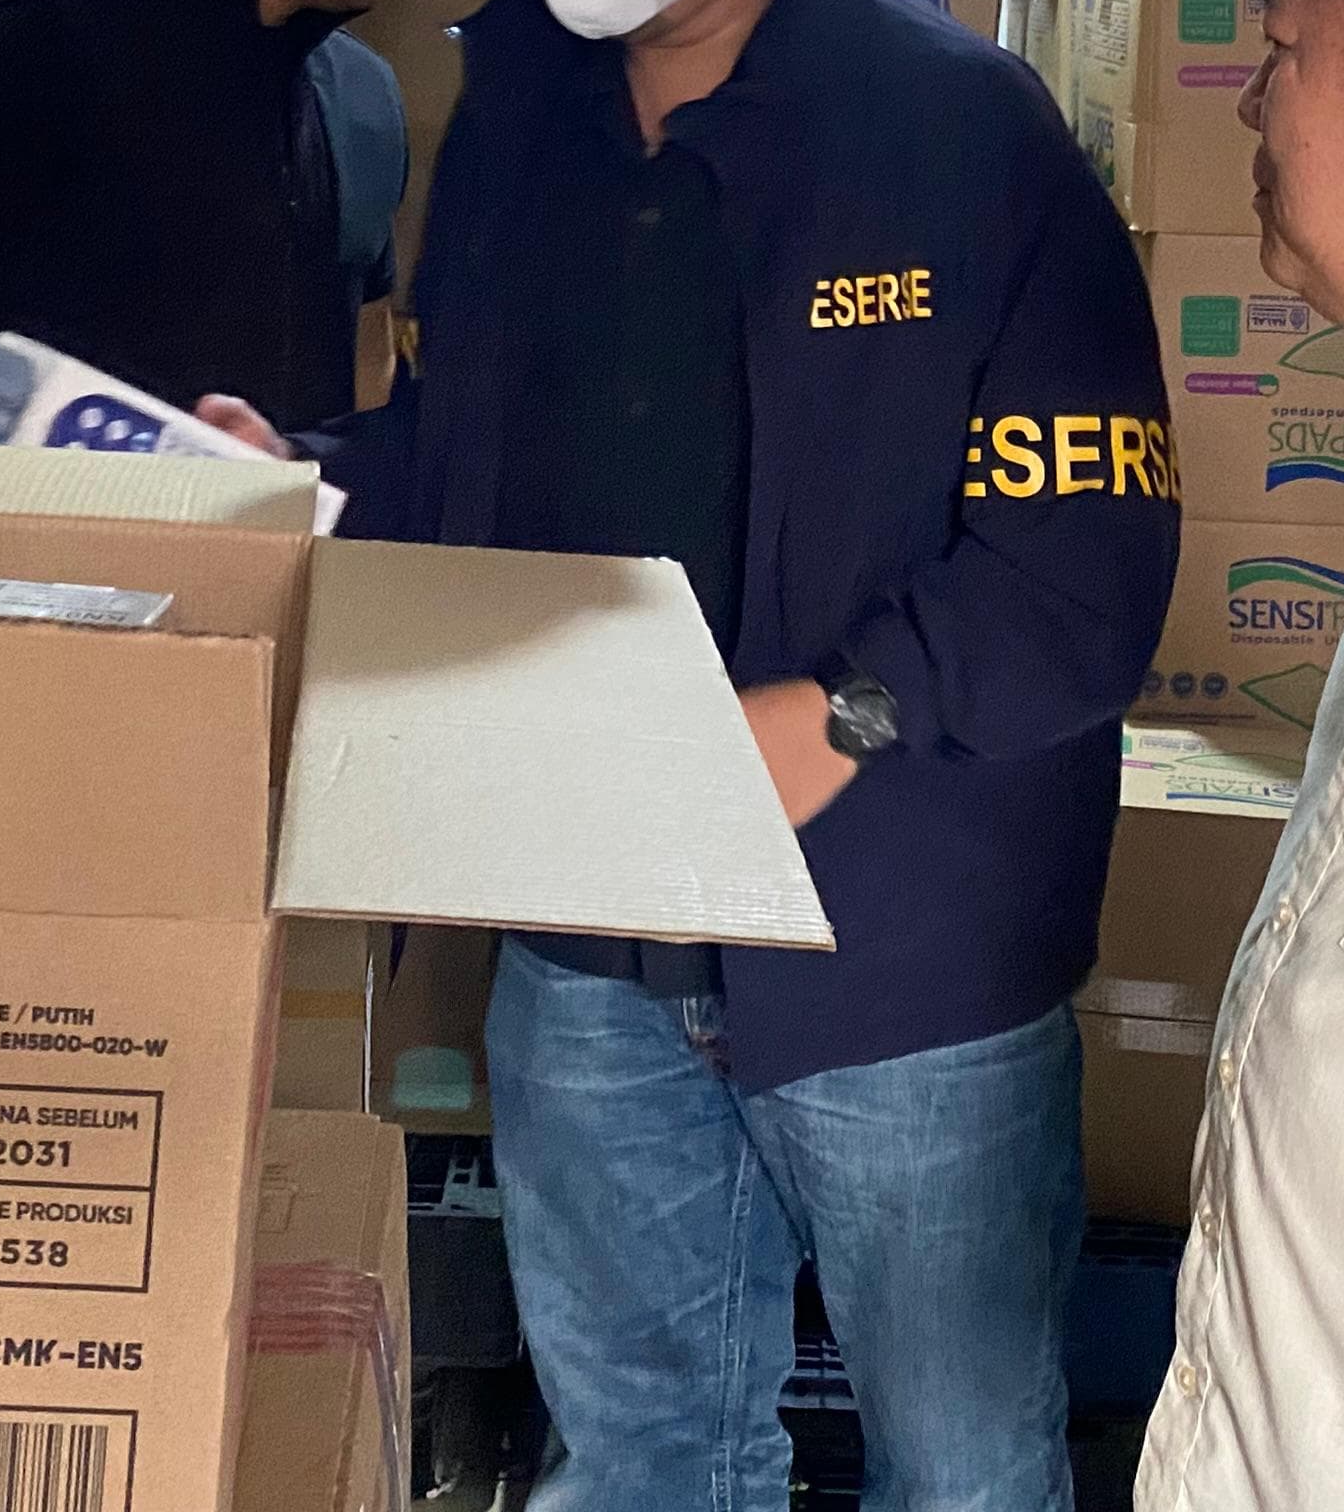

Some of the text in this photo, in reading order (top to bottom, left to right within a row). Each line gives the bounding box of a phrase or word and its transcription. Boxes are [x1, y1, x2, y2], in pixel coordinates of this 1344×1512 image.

[963, 414, 1182, 505] ESERS
[1228, 598, 1324, 631] SENSI
[1231, 633, 1315, 645] Disposable
[31, 1006, 94, 1028] PUTIH
[35, 1106, 139, 1131] SEBELUM
[16, 1201, 133, 1226] PRODUKSI
